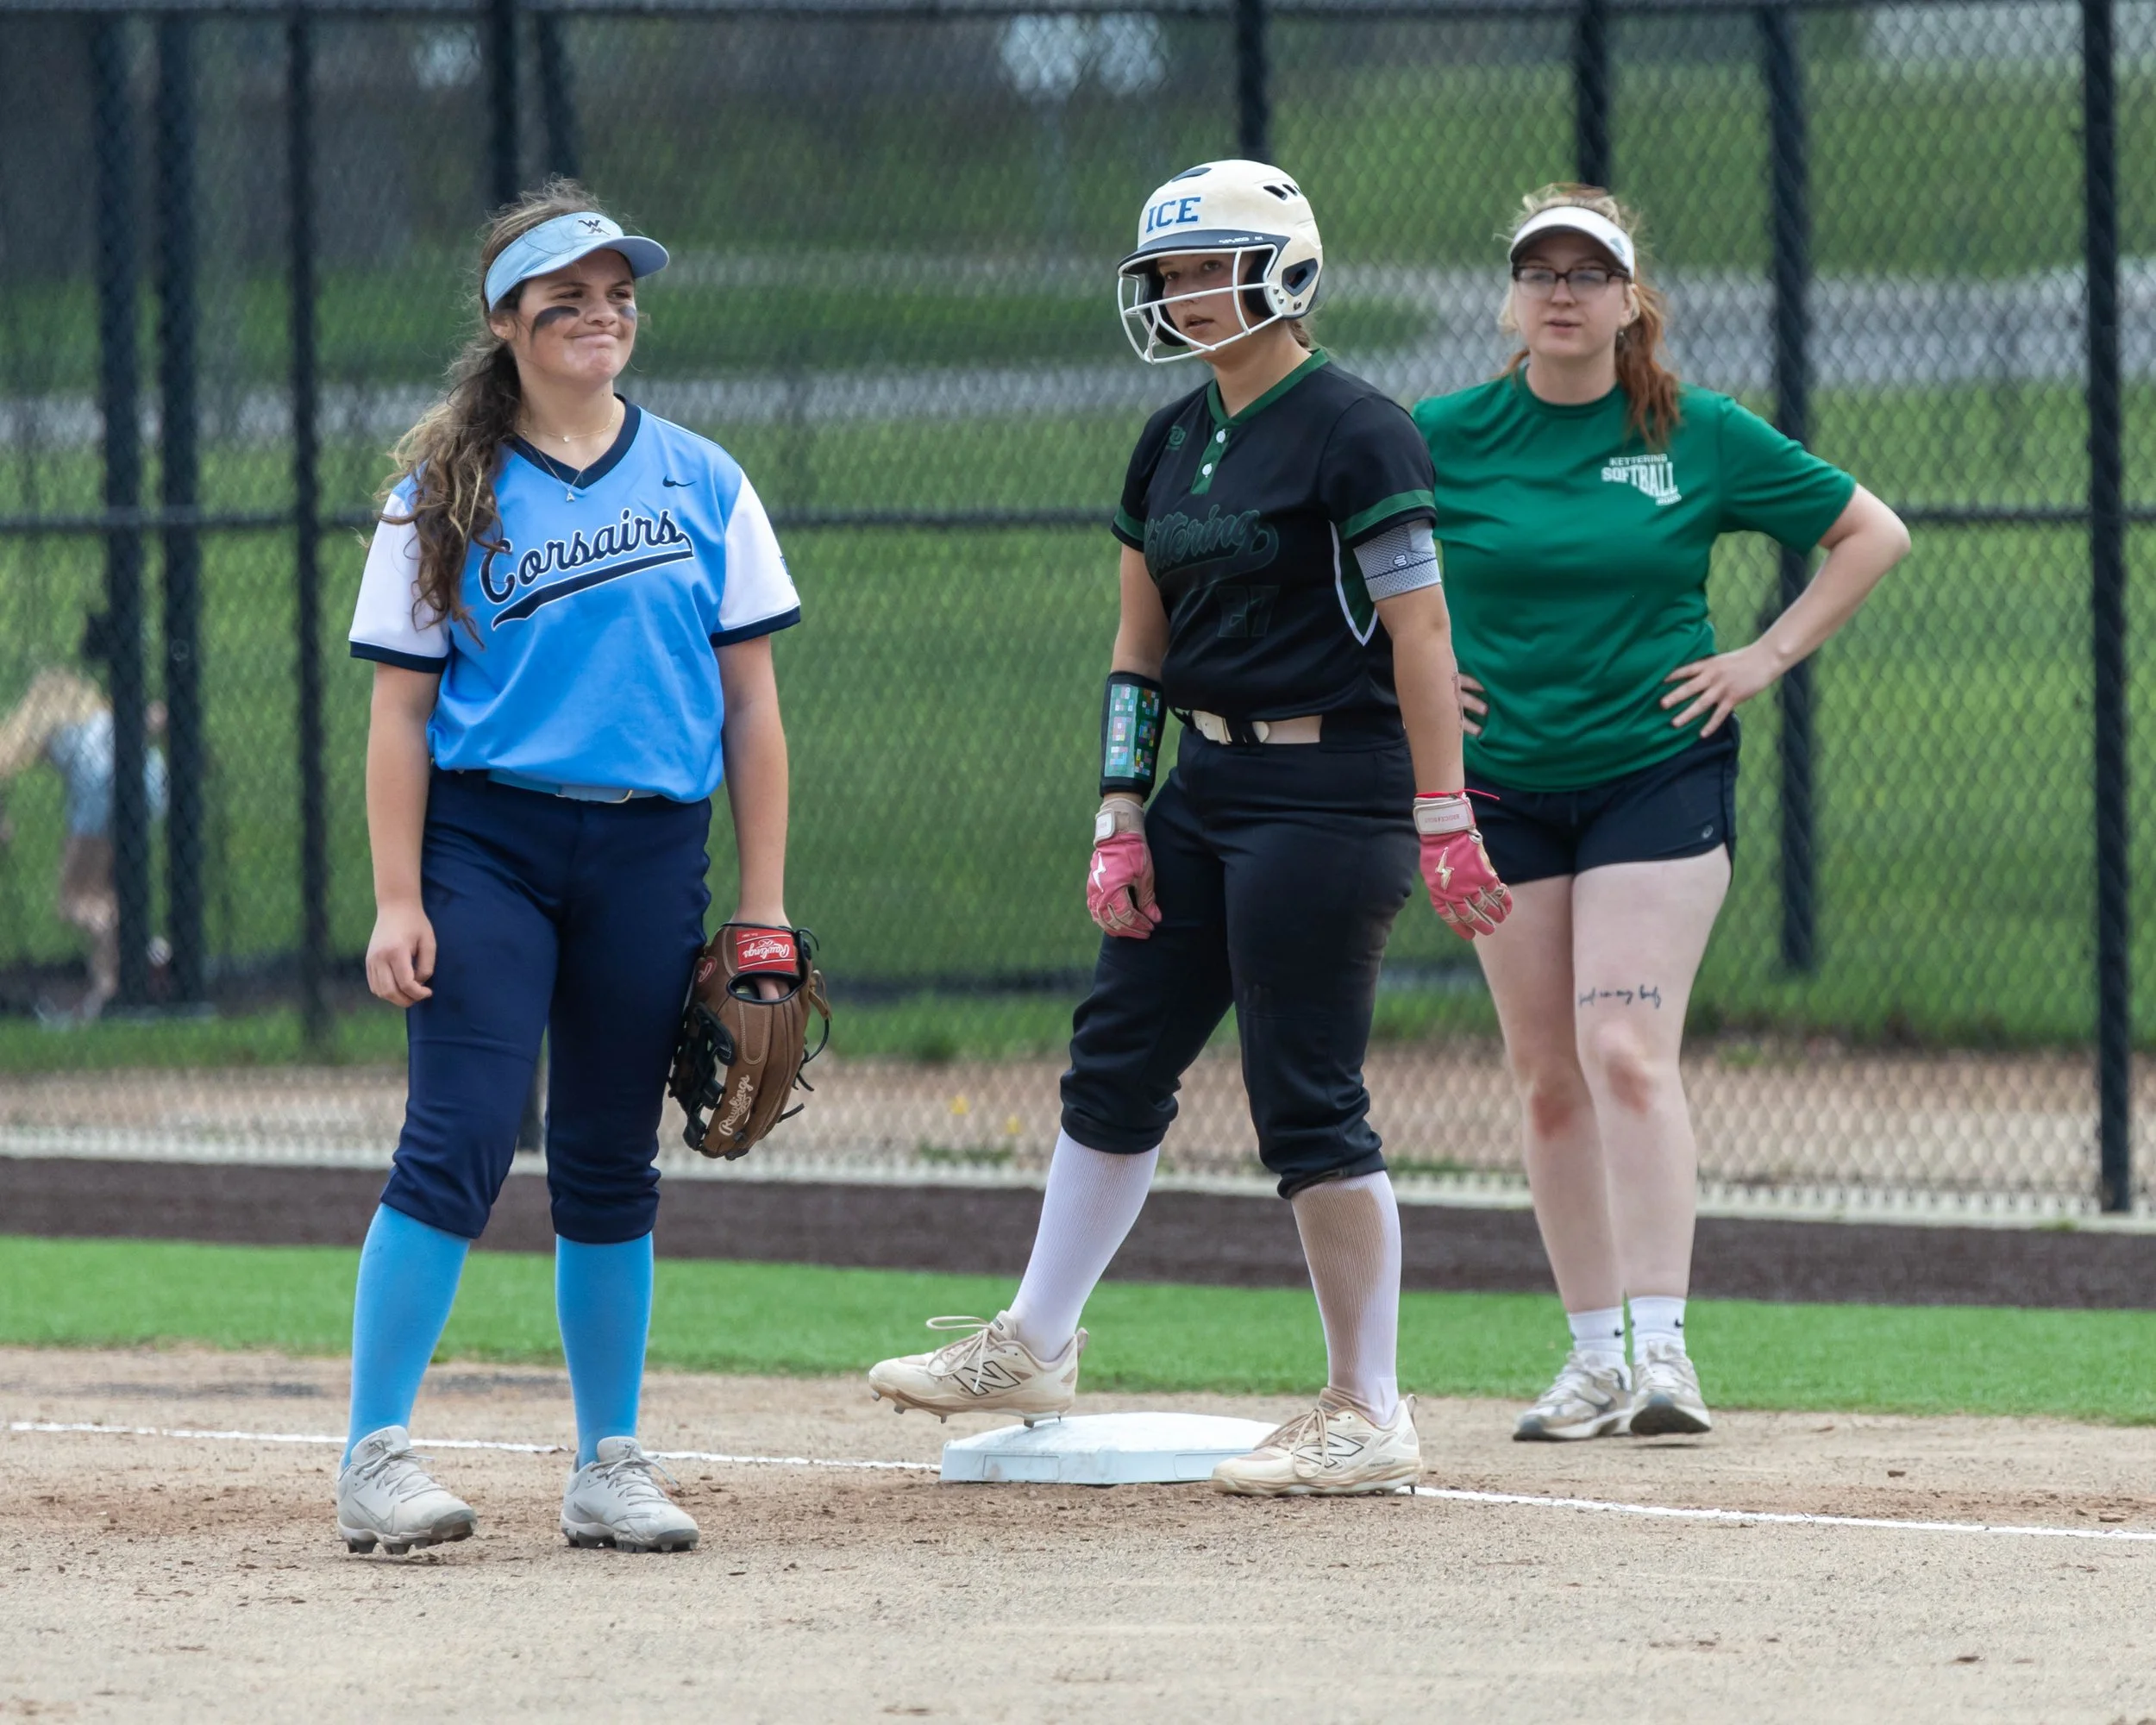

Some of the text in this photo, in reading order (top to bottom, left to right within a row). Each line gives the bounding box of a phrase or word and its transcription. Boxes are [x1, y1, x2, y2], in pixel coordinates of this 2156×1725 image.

[1146, 196, 1202, 233] ICE
[1609, 454, 1668, 467] KETTERING
[1601, 461, 1679, 498] SOFTBALL
[479, 507, 693, 605] Corsairs
[1216, 585, 1281, 638] 27
[743, 943, 790, 960] Rawlings
[718, 1074, 750, 1137] Rawlings
